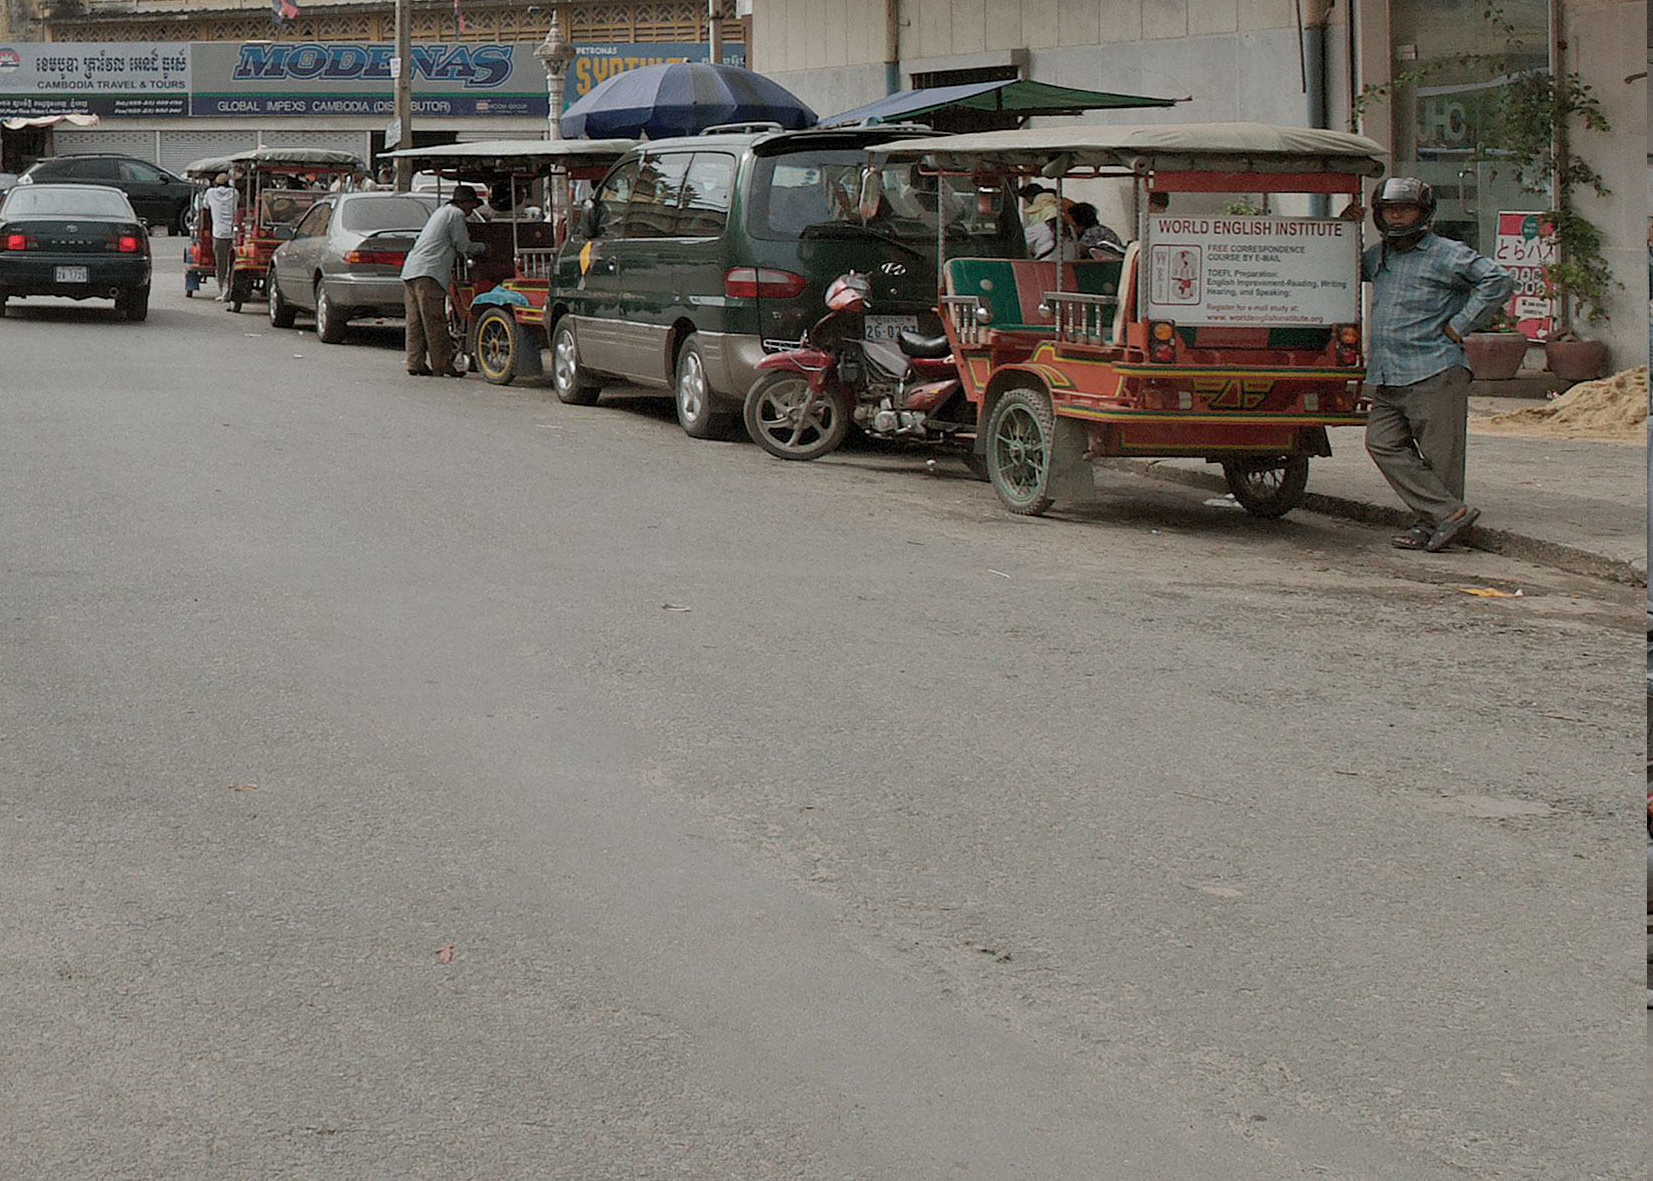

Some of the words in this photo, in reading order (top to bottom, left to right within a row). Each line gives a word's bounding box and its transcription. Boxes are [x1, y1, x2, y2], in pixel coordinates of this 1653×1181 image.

[576, 47, 618, 55] PETRONAS
[230, 42, 515, 89] MODENAS
[37, 80, 94, 90] CAMBODIA
[97, 80, 137, 89] TRAVEL
[140, 81, 146, 89] &
[150, 80, 186, 89] TOURS
[217, 101, 261, 112] GLOBAL
[312, 101, 370, 112] CAMBODIA
[1158, 220, 1210, 234] WORLD
[1213, 221, 1272, 235] ENGLISH
[1275, 222, 1343, 236] INSTITUTE
[1207, 244, 1229, 252] FREE
[1229, 245, 1306, 254] CORRESPONDENCE
[1207, 254, 1241, 262] COURSE
[1242, 254, 1253, 262] BY
[1207, 269, 1232, 277] TOEFL
[1207, 279, 1234, 288] English
[1206, 303, 1235, 312] Register
[1270, 304, 1290, 313] study
